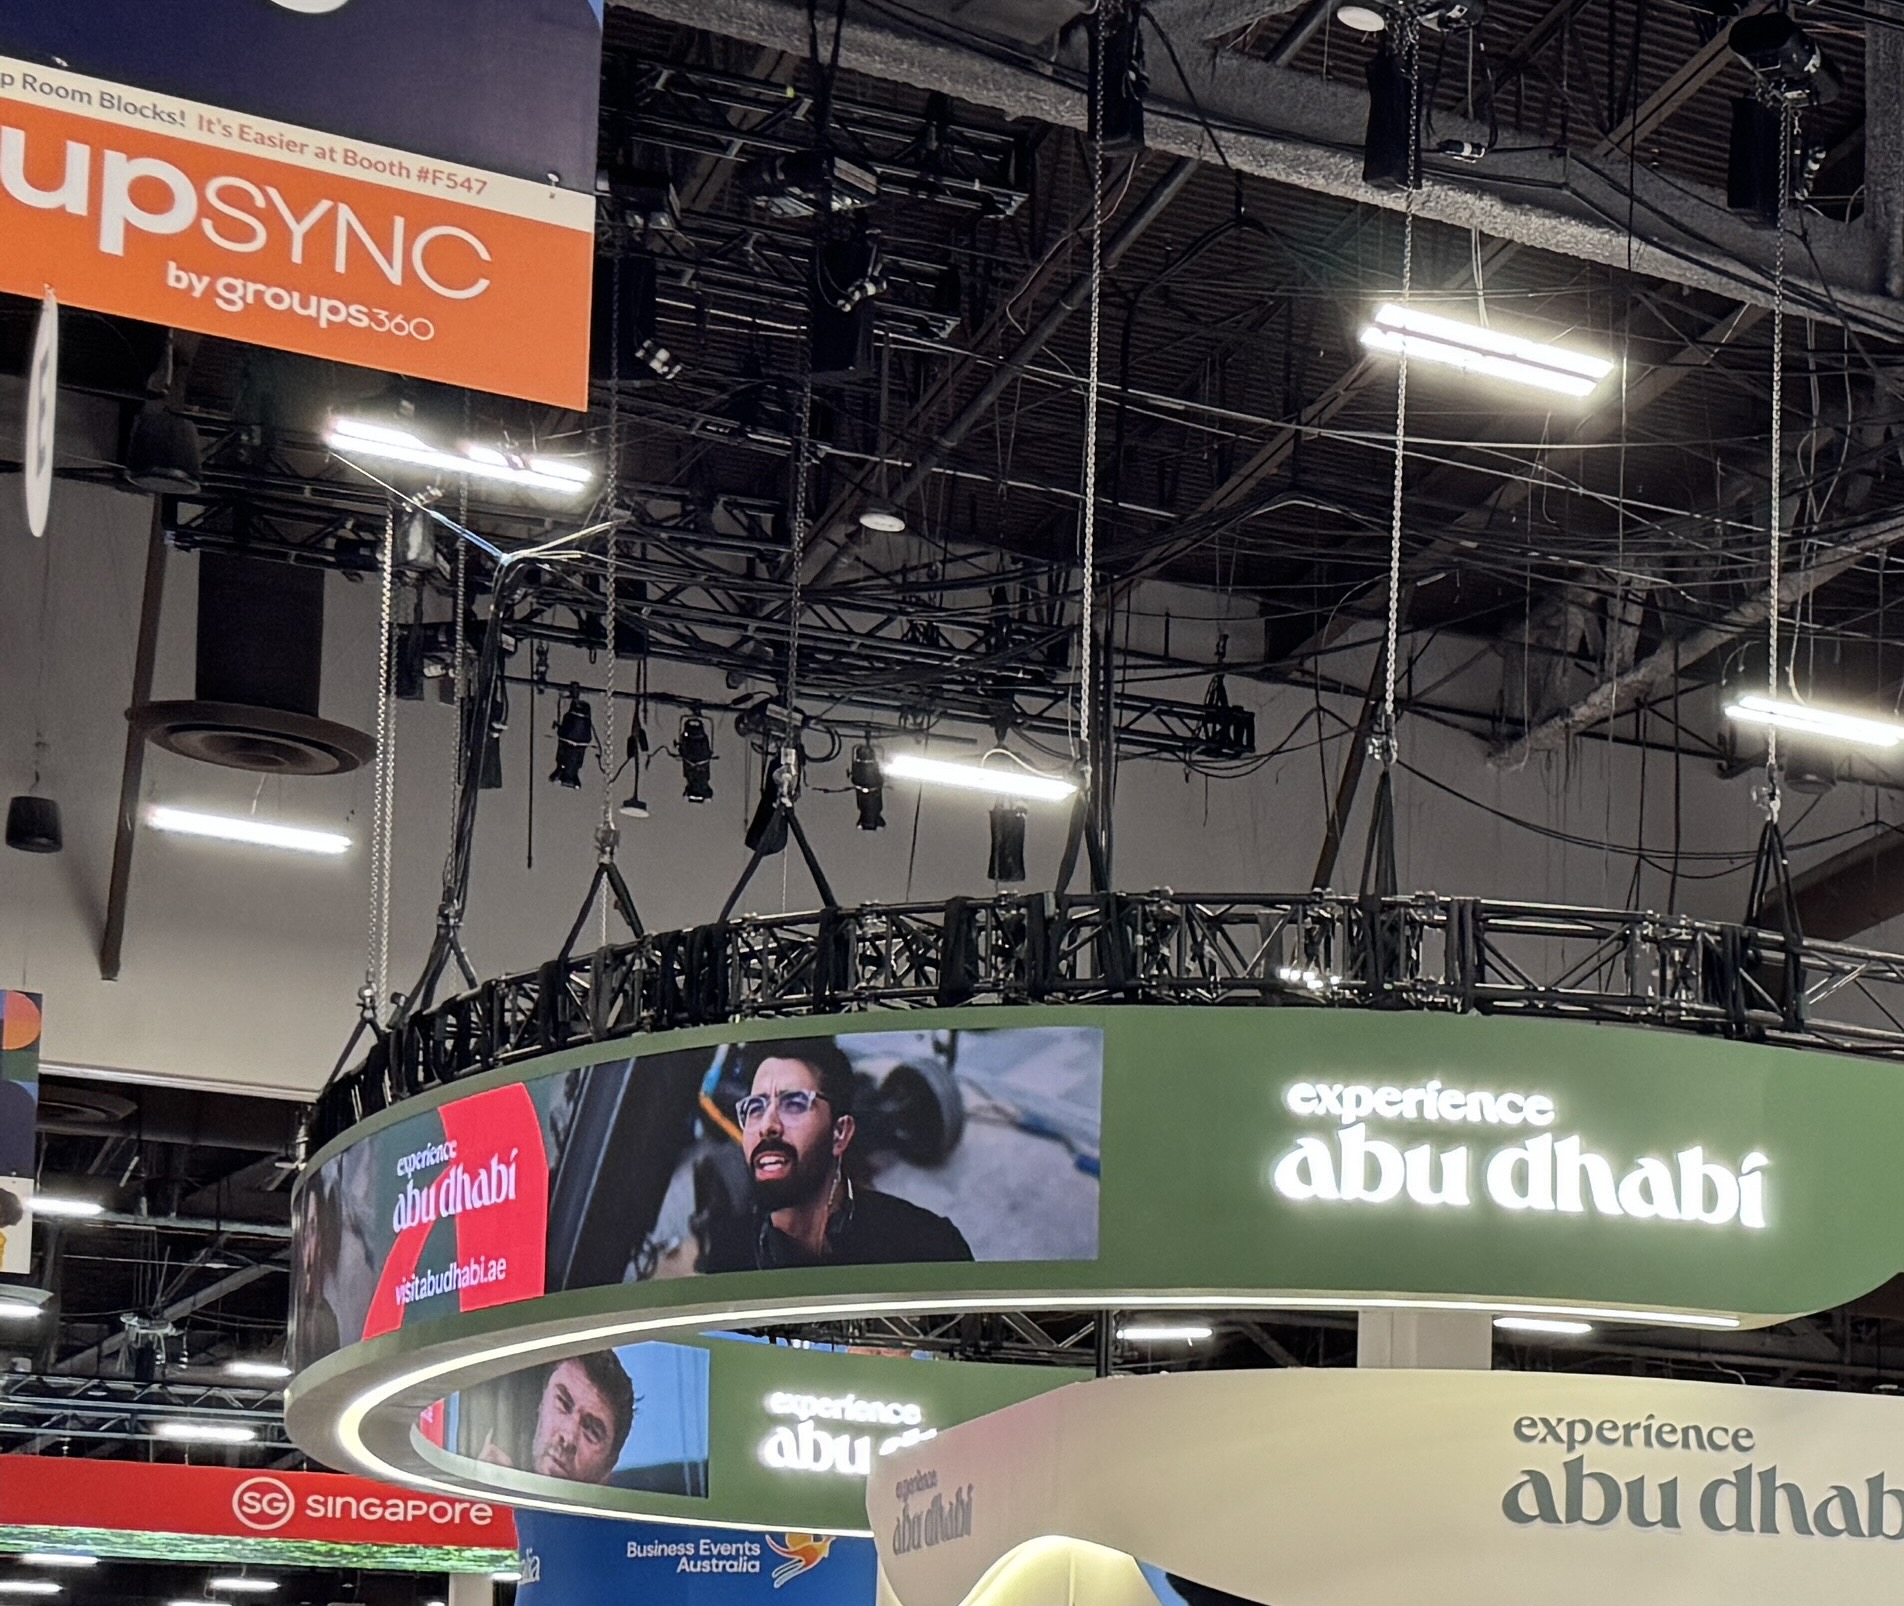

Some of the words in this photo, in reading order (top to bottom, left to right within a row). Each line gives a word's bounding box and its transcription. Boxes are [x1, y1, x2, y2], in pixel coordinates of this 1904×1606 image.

[22, 75, 93, 106] Room
[100, 91, 186, 127] Blocks!
[199, 114, 233, 138] It's
[239, 125, 309, 155] Easier
[315, 143, 337, 162] at
[344, 148, 411, 180] Booth
[417, 166, 488, 195] #F547
[167, 261, 210, 297] by
[216, 277, 435, 342] groups360
[1287, 1081, 1556, 1127] experience
[397, 1140, 458, 1179] experience
[1274, 1122, 1472, 1206] abu
[1486, 1134, 1770, 1229] dhabi
[393, 1179, 436, 1233] abu
[439, 1148, 518, 1217] dhabi
[396, 1256, 507, 1305] visitabudhabi.ae
[763, 1420, 871, 1474] abu
[1513, 1414, 1756, 1454] experience
[242, 1491, 287, 1515] SG
[1502, 1456, 1680, 1530] abu
[627, 1540, 694, 1559] Business
[699, 1539, 760, 1556] Events
[676, 1556, 760, 1573] Australia
